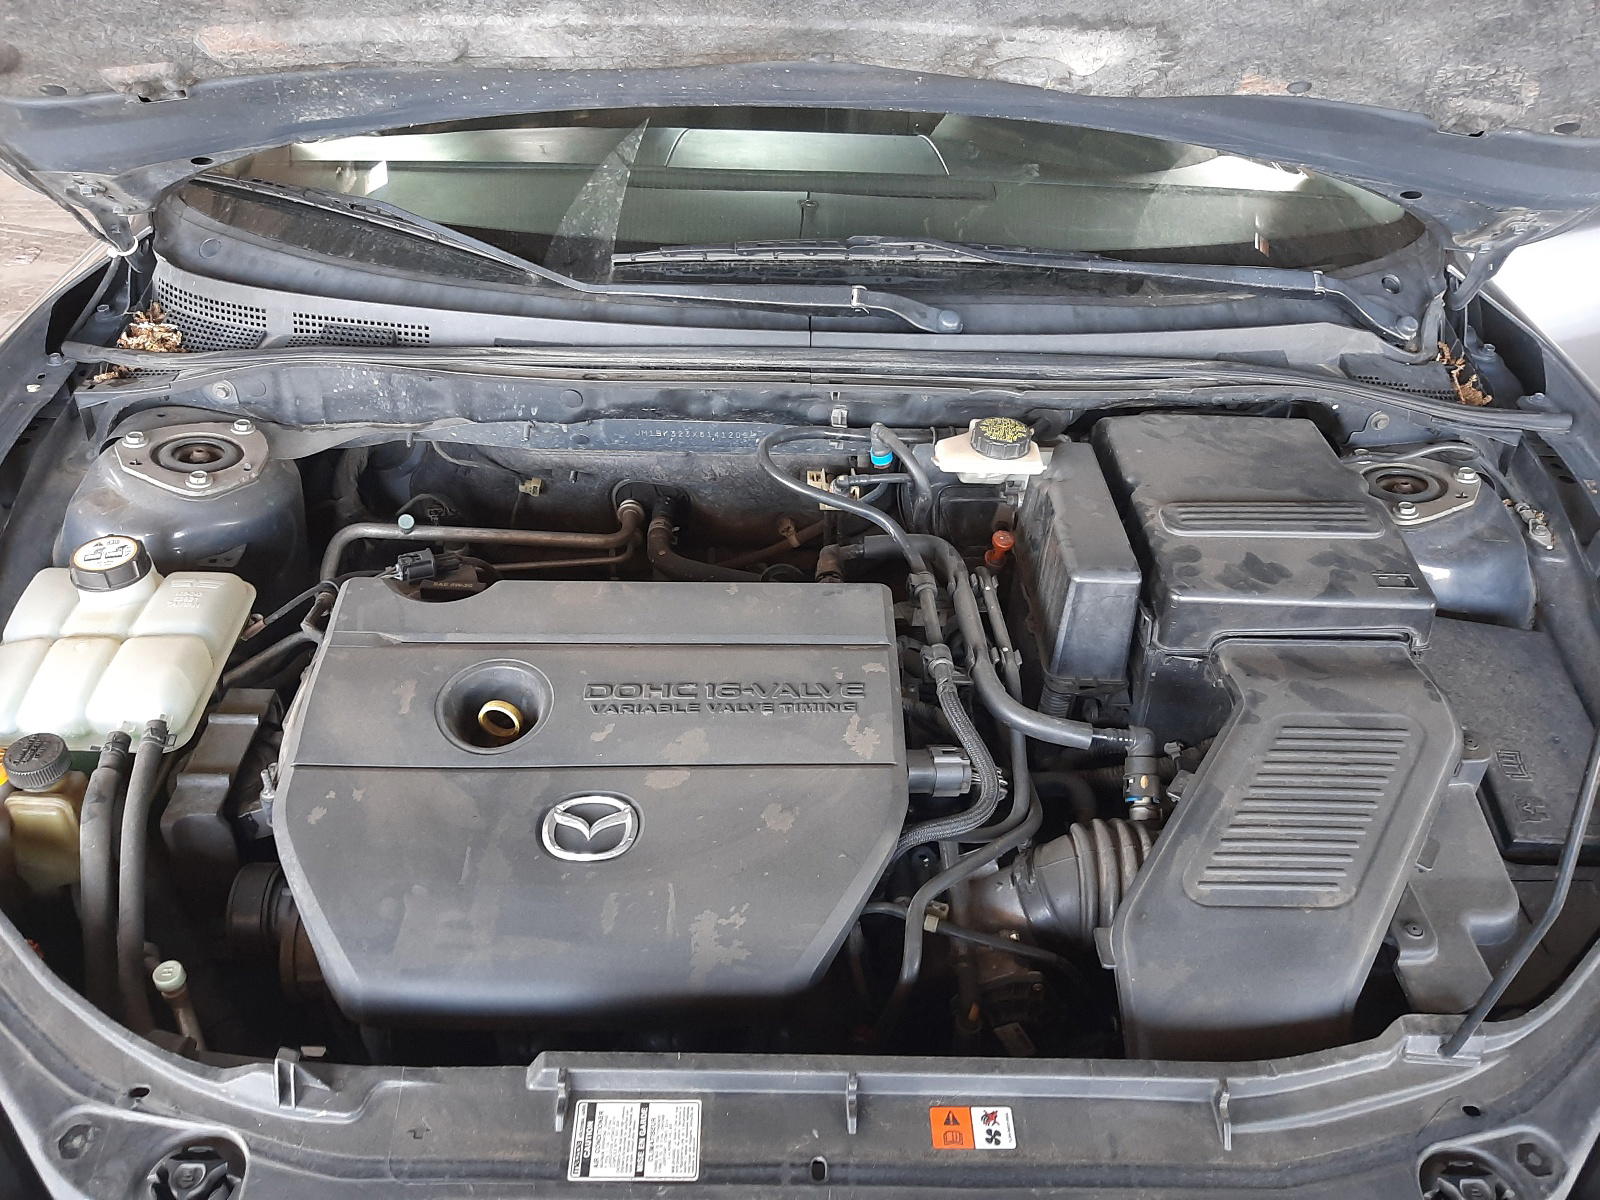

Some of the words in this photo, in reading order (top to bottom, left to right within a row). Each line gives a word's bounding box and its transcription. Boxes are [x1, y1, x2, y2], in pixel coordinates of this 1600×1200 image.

[583, 683, 698, 700] DOHC
[705, 683, 866, 700] 16-VALVE
[589, 702, 701, 715] VARIABLE
[706, 702, 774, 715] VALVE
[779, 702, 858, 714] TIMING
[639, 1107, 648, 1136] GARDE
[583, 1120, 594, 1158] CAUTION
[637, 1137, 645, 1149] EN
